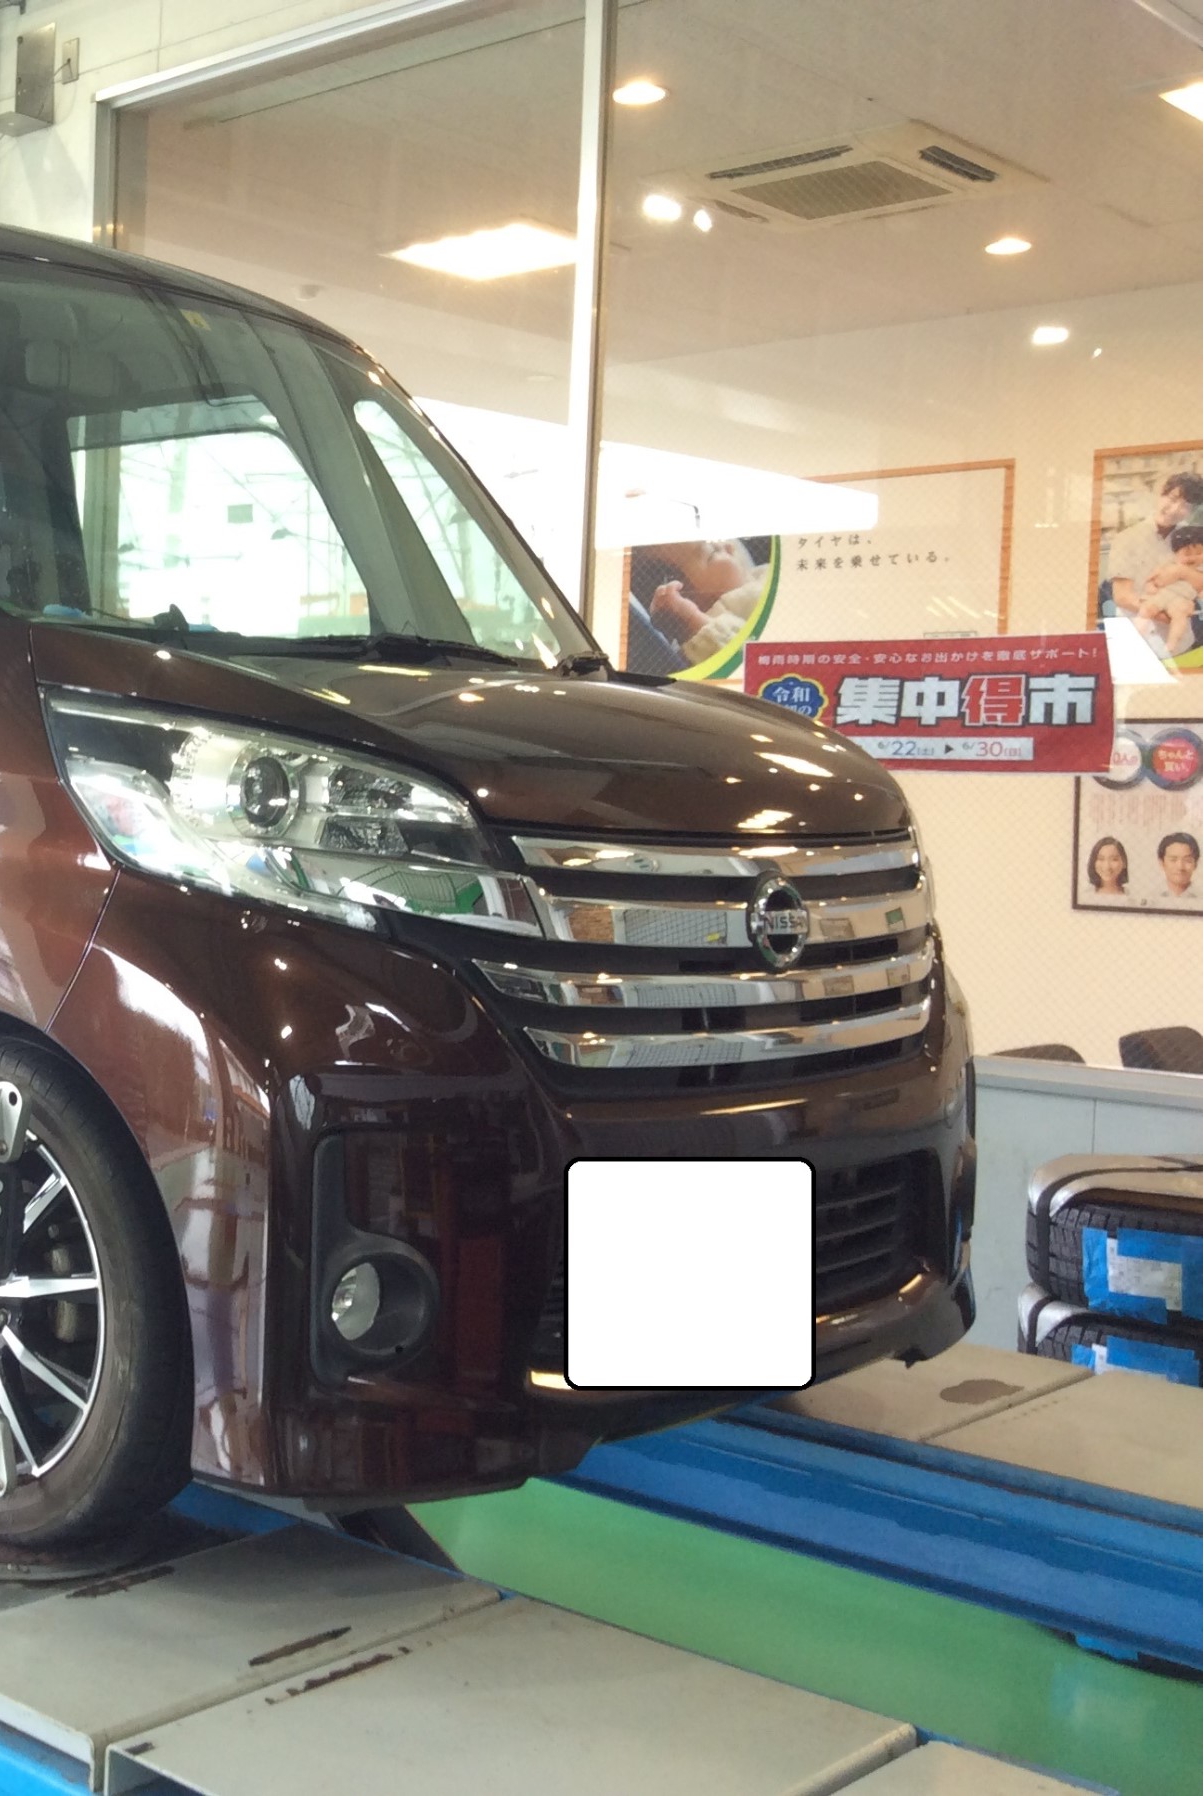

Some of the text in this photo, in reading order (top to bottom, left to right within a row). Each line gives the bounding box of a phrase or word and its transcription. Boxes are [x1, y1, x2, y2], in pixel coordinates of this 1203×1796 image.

[798, 534, 872, 548] タイヤは、
[797, 551, 950, 571] 未来を乗せている。
[772, 686, 811, 702] 令和
[836, 673, 1096, 726] 集中得市
